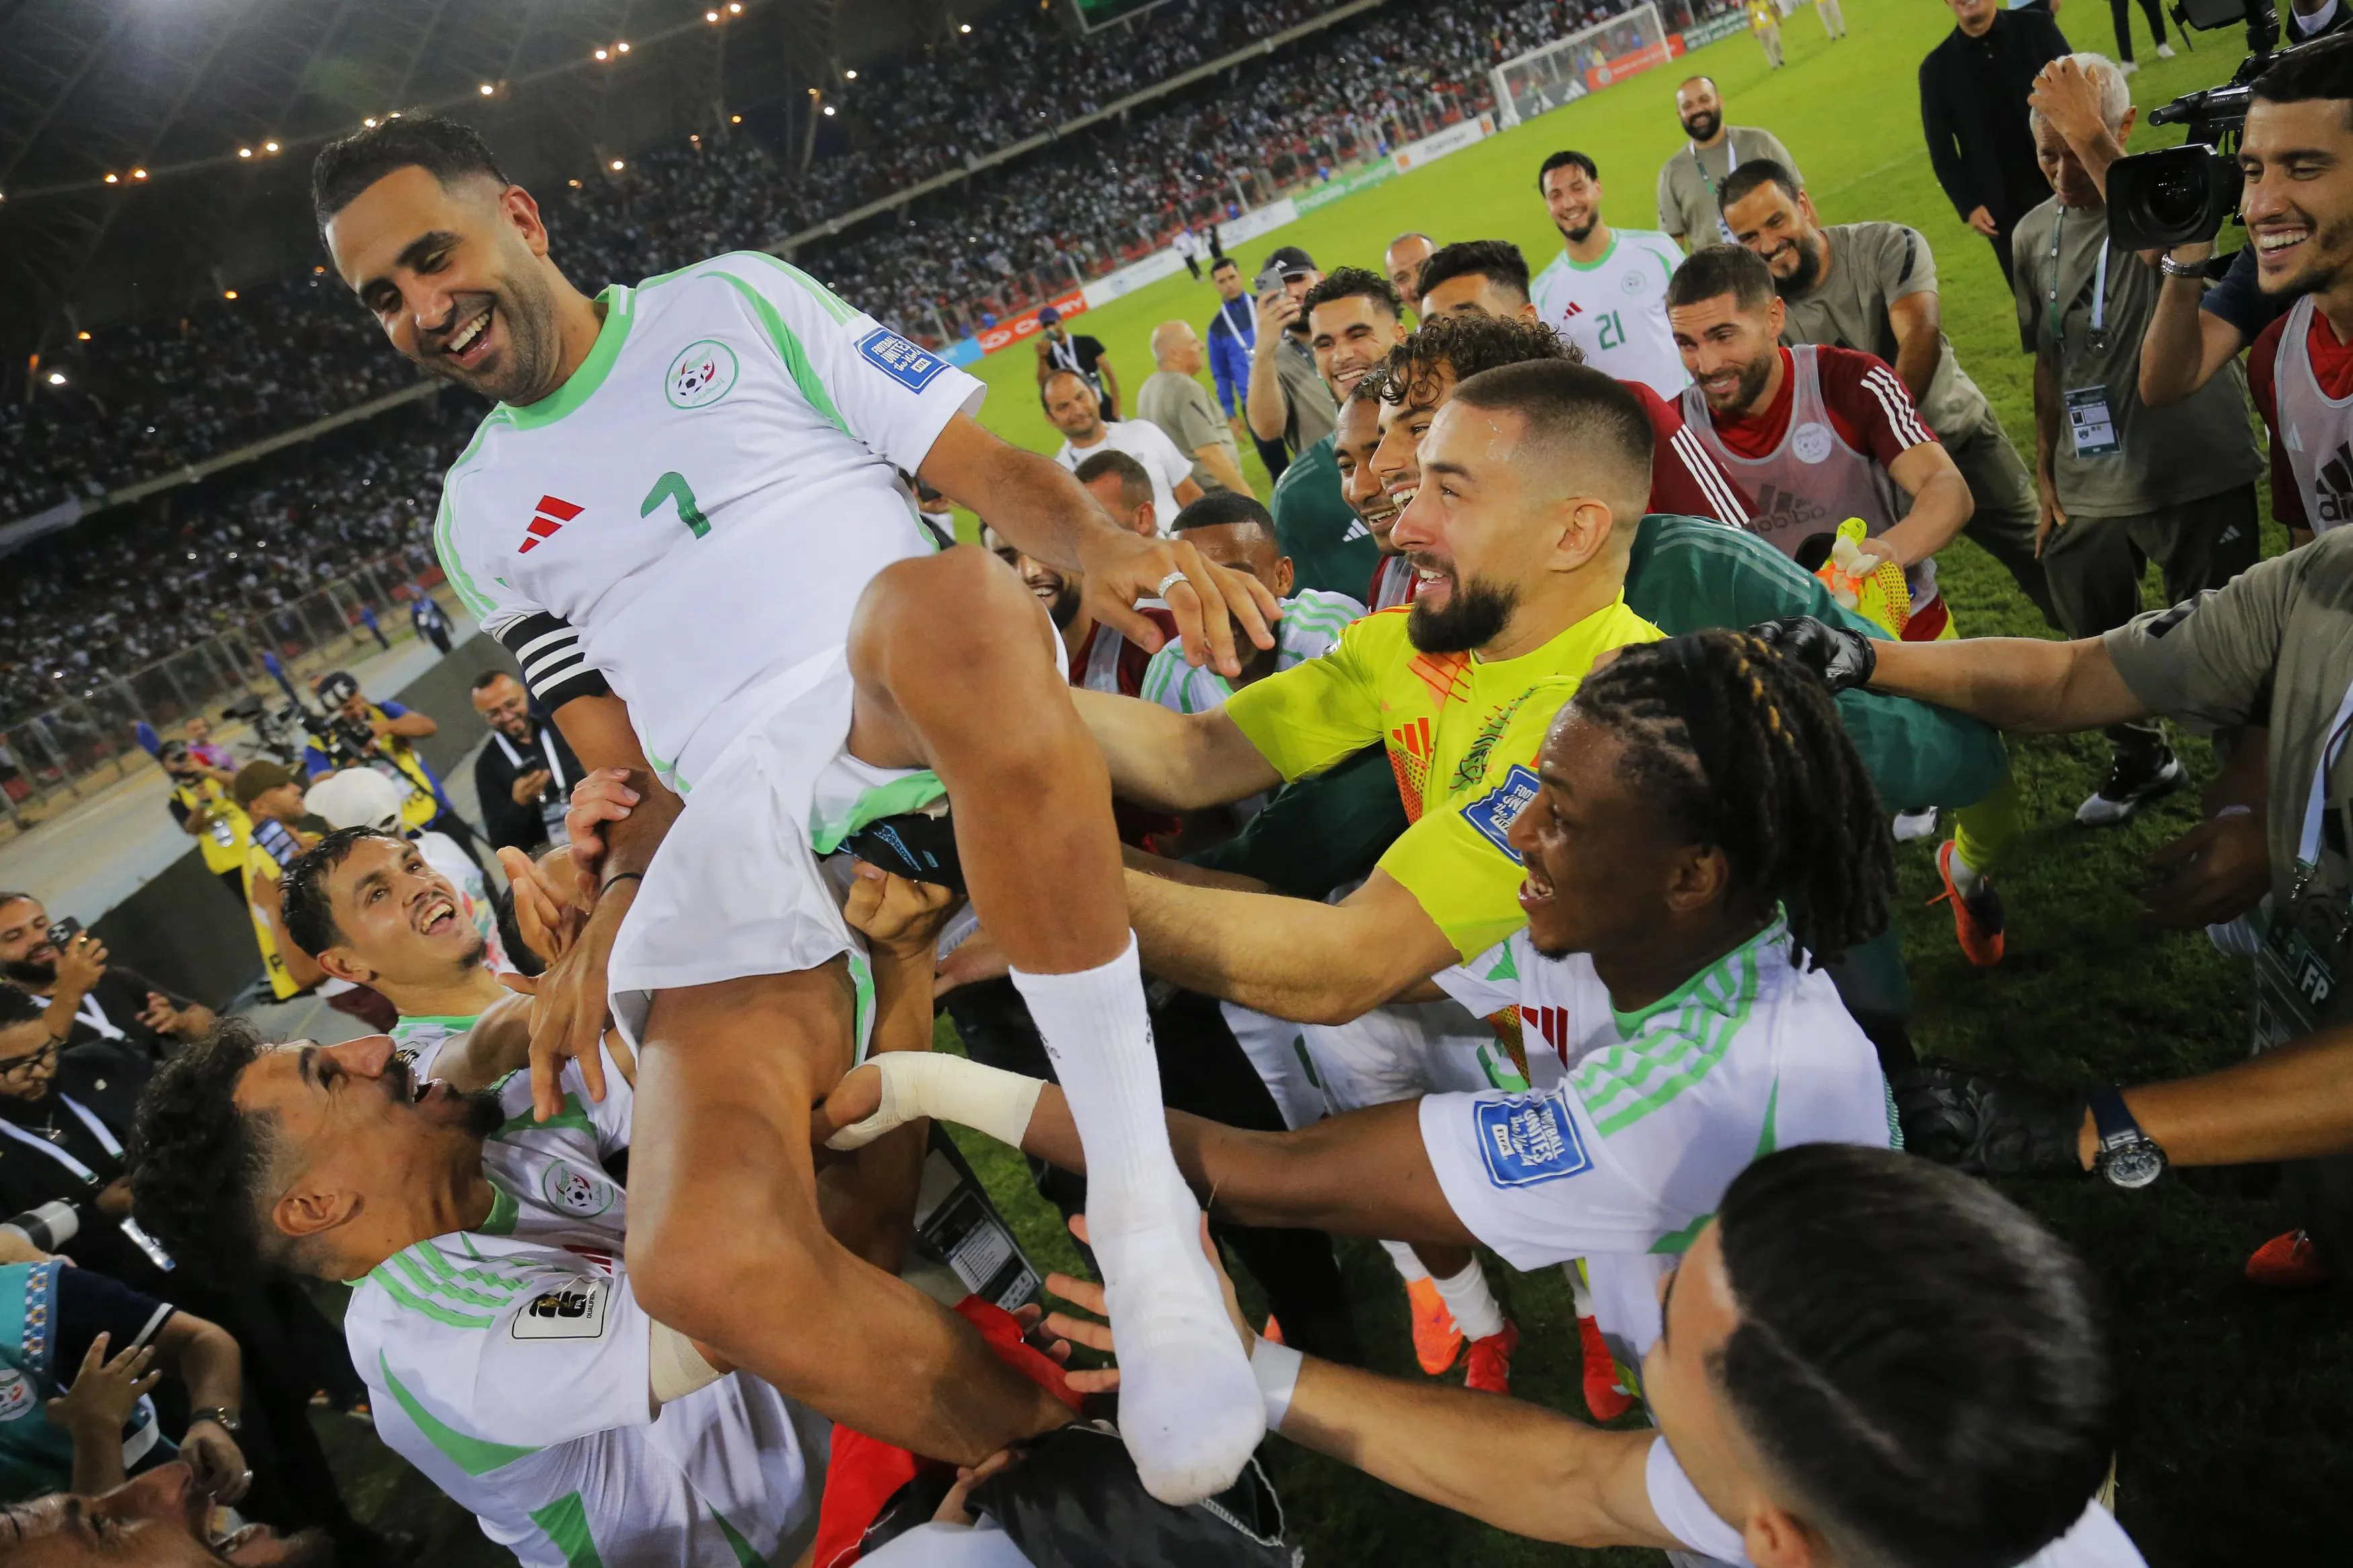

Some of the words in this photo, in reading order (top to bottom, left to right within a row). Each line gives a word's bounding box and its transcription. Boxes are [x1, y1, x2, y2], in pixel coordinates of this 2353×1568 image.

[871, 335, 899, 356] FOOTBALL
[1594, 309, 1626, 351] 21
[880, 341, 911, 364] UNITES
[914, 360, 928, 370] FIFA
[2301, 963, 2329, 1004] FP
[1497, 1128, 1509, 1151] FIFA
[1523, 1109, 1553, 1164] UNITES
[1540, 1108, 1565, 1159] FOOTBALL
